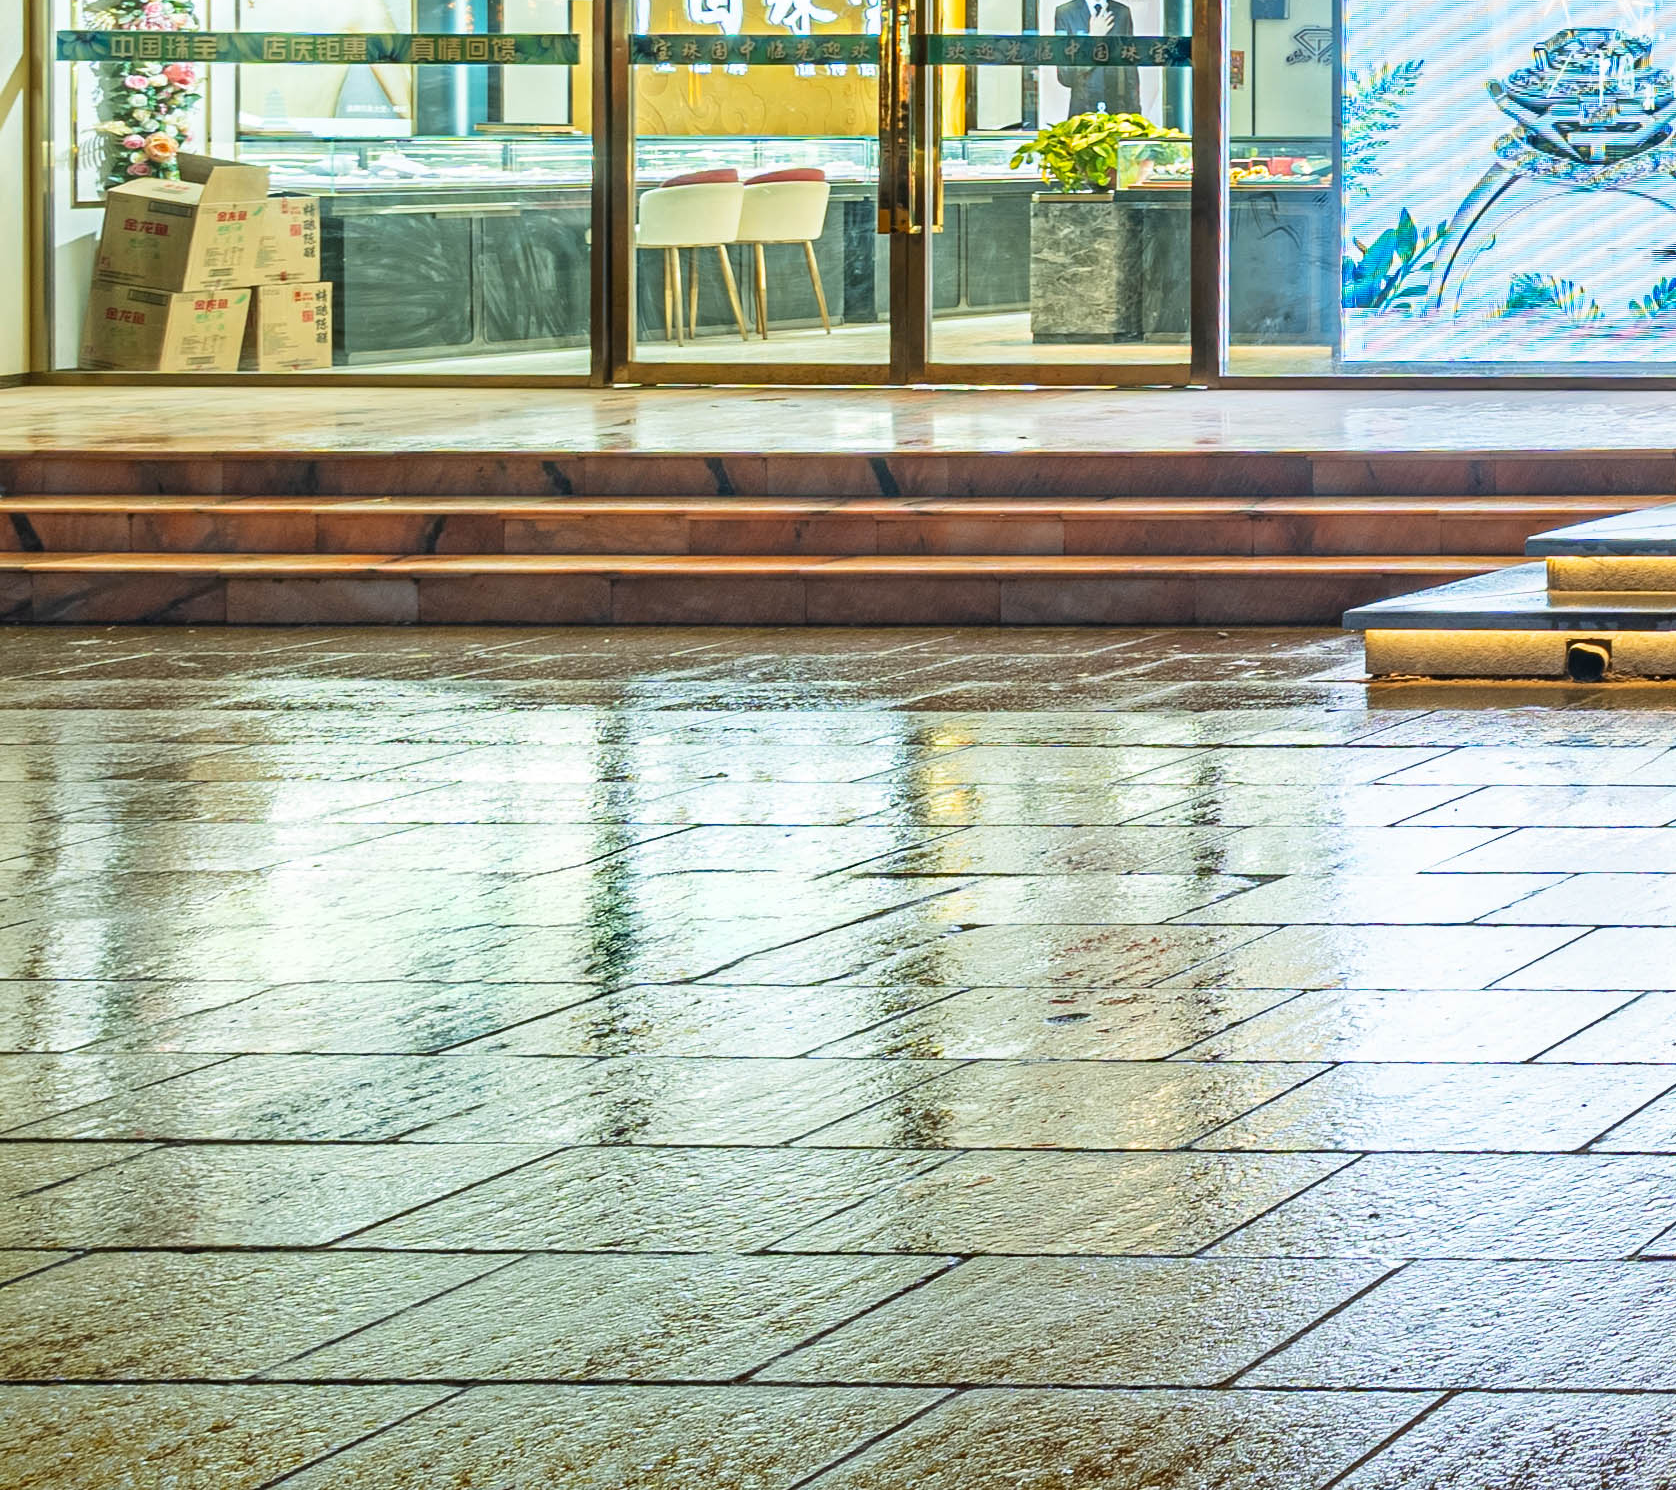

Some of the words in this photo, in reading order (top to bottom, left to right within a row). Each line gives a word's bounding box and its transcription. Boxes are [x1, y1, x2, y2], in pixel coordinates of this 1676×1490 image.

[111, 35, 217, 61] 中国珠宝
[263, 36, 367, 61] 店庆钜惠
[410, 37, 516, 63] 真情回馈
[945, 39, 1168, 64] 欢迎光临中国珠宝
